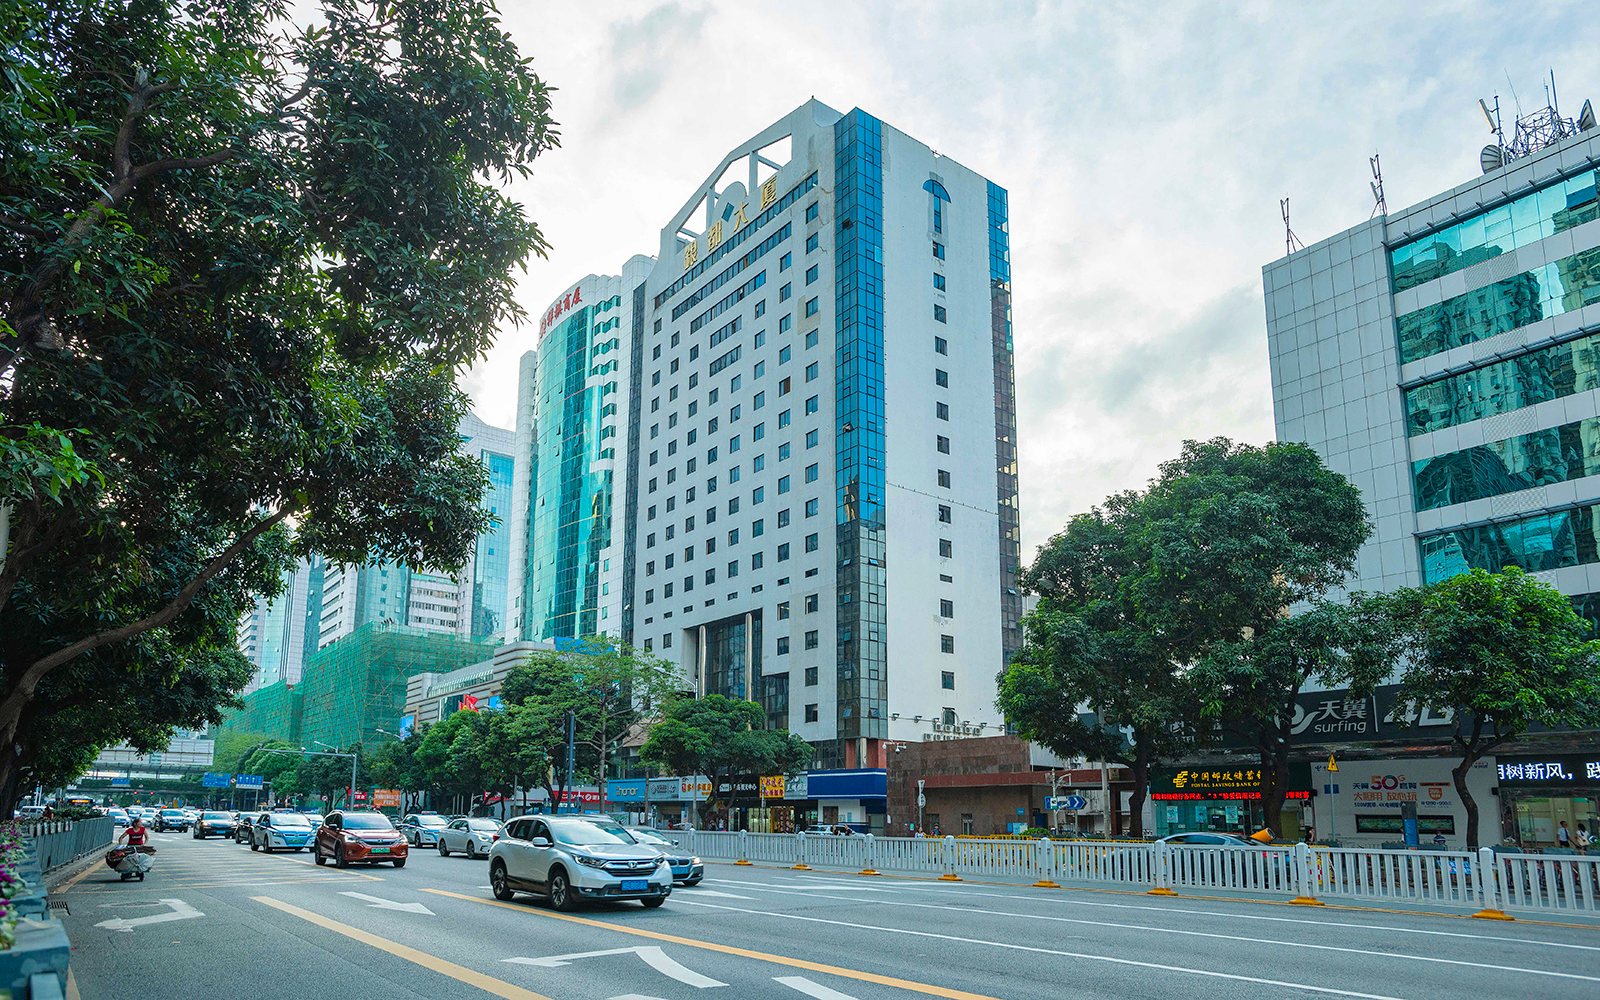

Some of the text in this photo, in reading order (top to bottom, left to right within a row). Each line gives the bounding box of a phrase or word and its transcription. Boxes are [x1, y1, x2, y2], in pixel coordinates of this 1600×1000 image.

[1317, 700, 1367, 721] 天翼
[1314, 718, 1367, 735] surfing
[1353, 791, 1383, 801] 大胆用
[1386, 790, 1418, 801] 放心玩
